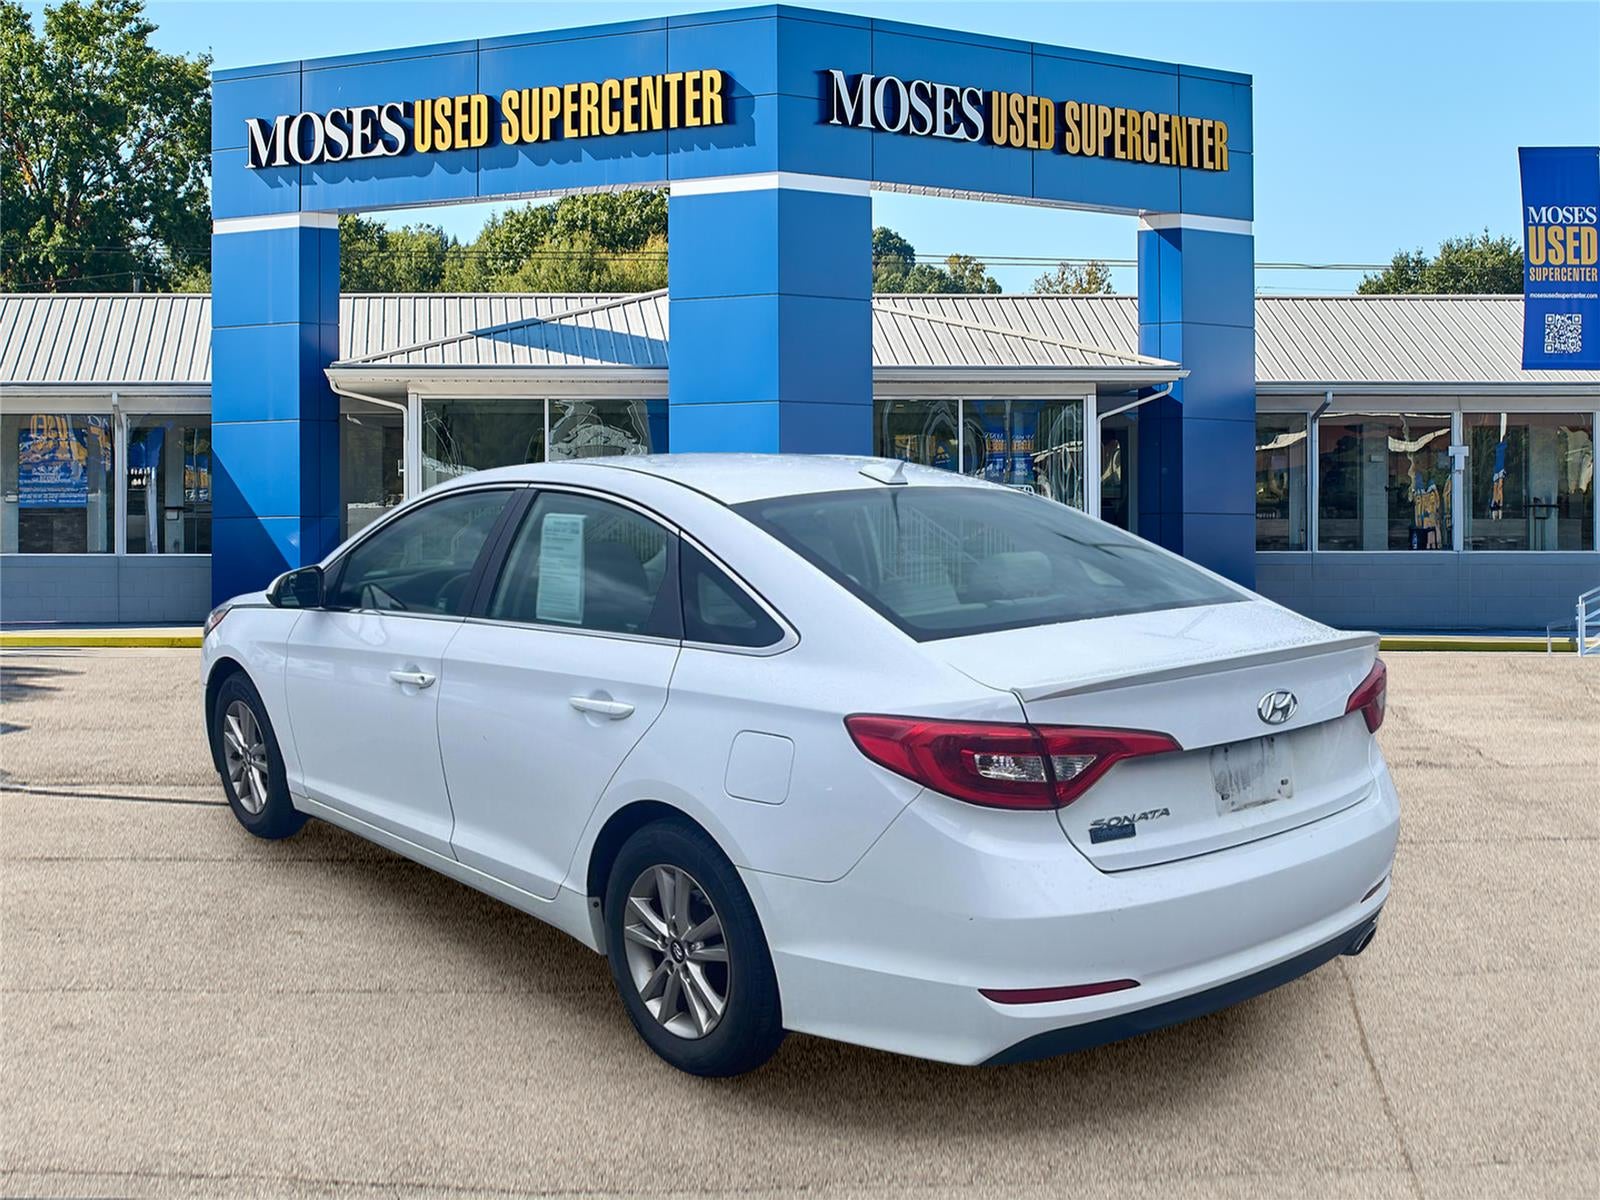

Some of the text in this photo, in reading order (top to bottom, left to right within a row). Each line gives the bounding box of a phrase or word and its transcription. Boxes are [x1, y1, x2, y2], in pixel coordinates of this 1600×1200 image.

[245, 68, 726, 169] MOSES USED SUPERCENTER
[828, 69, 1228, 171] MOSES USED SUPERCENTER
[1528, 206, 1597, 224] MOSES
[1528, 225, 1598, 265] USED
[1529, 267, 1598, 282] SUPERCENTER
[1090, 807, 1171, 827] SONATA
